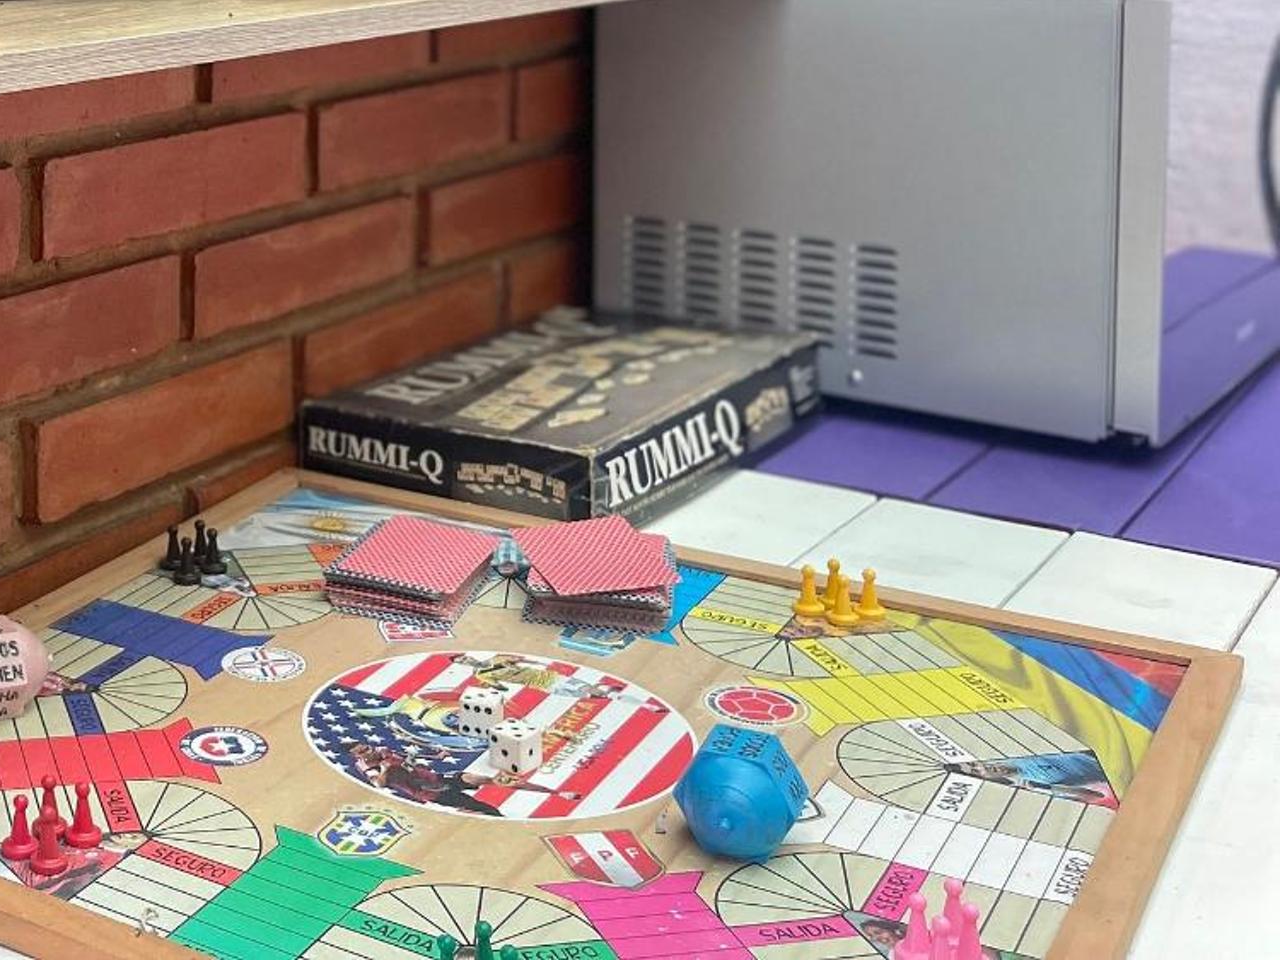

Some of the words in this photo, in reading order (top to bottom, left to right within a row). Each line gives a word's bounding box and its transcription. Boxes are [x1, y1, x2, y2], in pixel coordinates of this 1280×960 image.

[308, 425, 444, 484] RUMMI-Q
[606, 398, 744, 508] RUMMI-Q
[941, 780, 972, 813] SALIDA
[153, 846, 227, 880] SEGURO
[1053, 856, 1089, 898] SEGURO
[873, 869, 915, 912] SEGURO
[359, 918, 434, 954] SALIDA
[758, 921, 841, 943] SALIDA
[520, 943, 598, 960] EGURO
